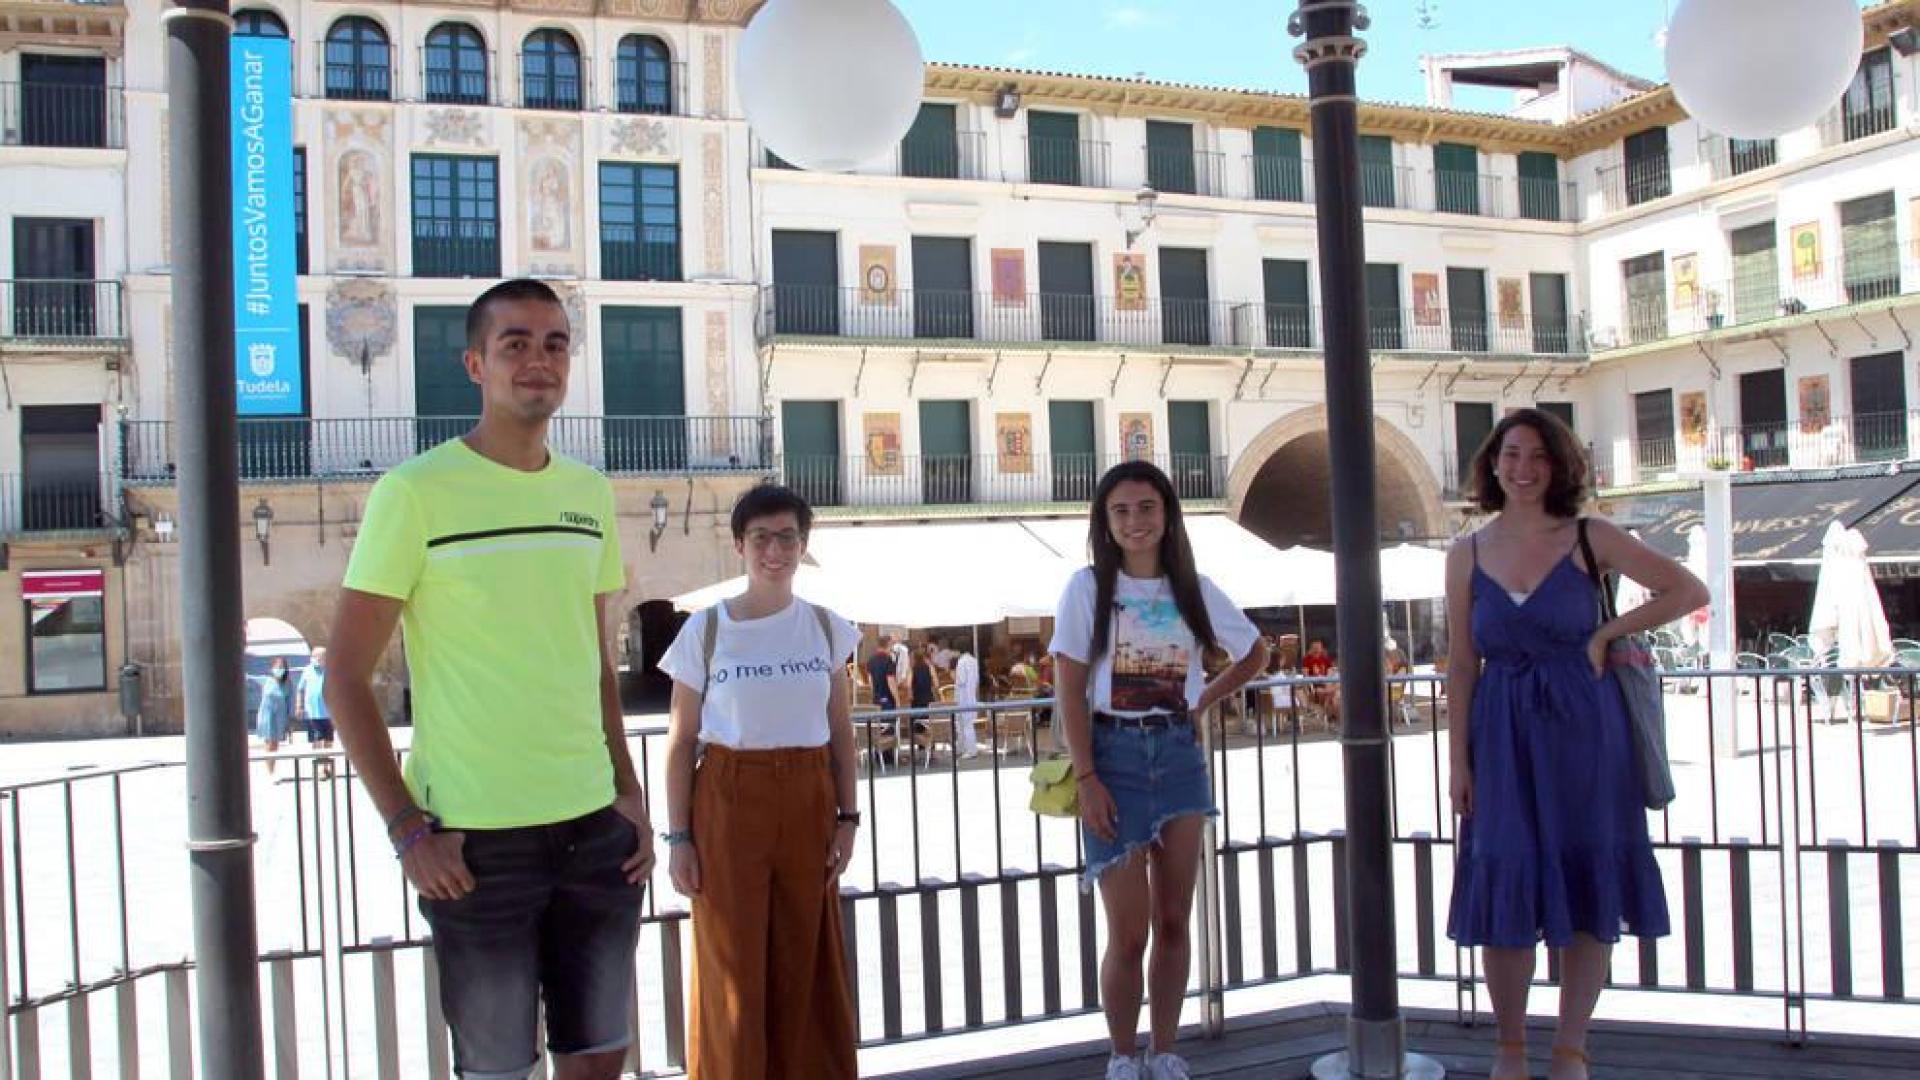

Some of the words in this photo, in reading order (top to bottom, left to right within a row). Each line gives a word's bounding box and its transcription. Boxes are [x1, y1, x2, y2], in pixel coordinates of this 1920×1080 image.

[241, 50, 271, 316] #JuntosVamosAGanar
[236, 380, 291, 393] Tudela
[736, 663, 773, 679] me
